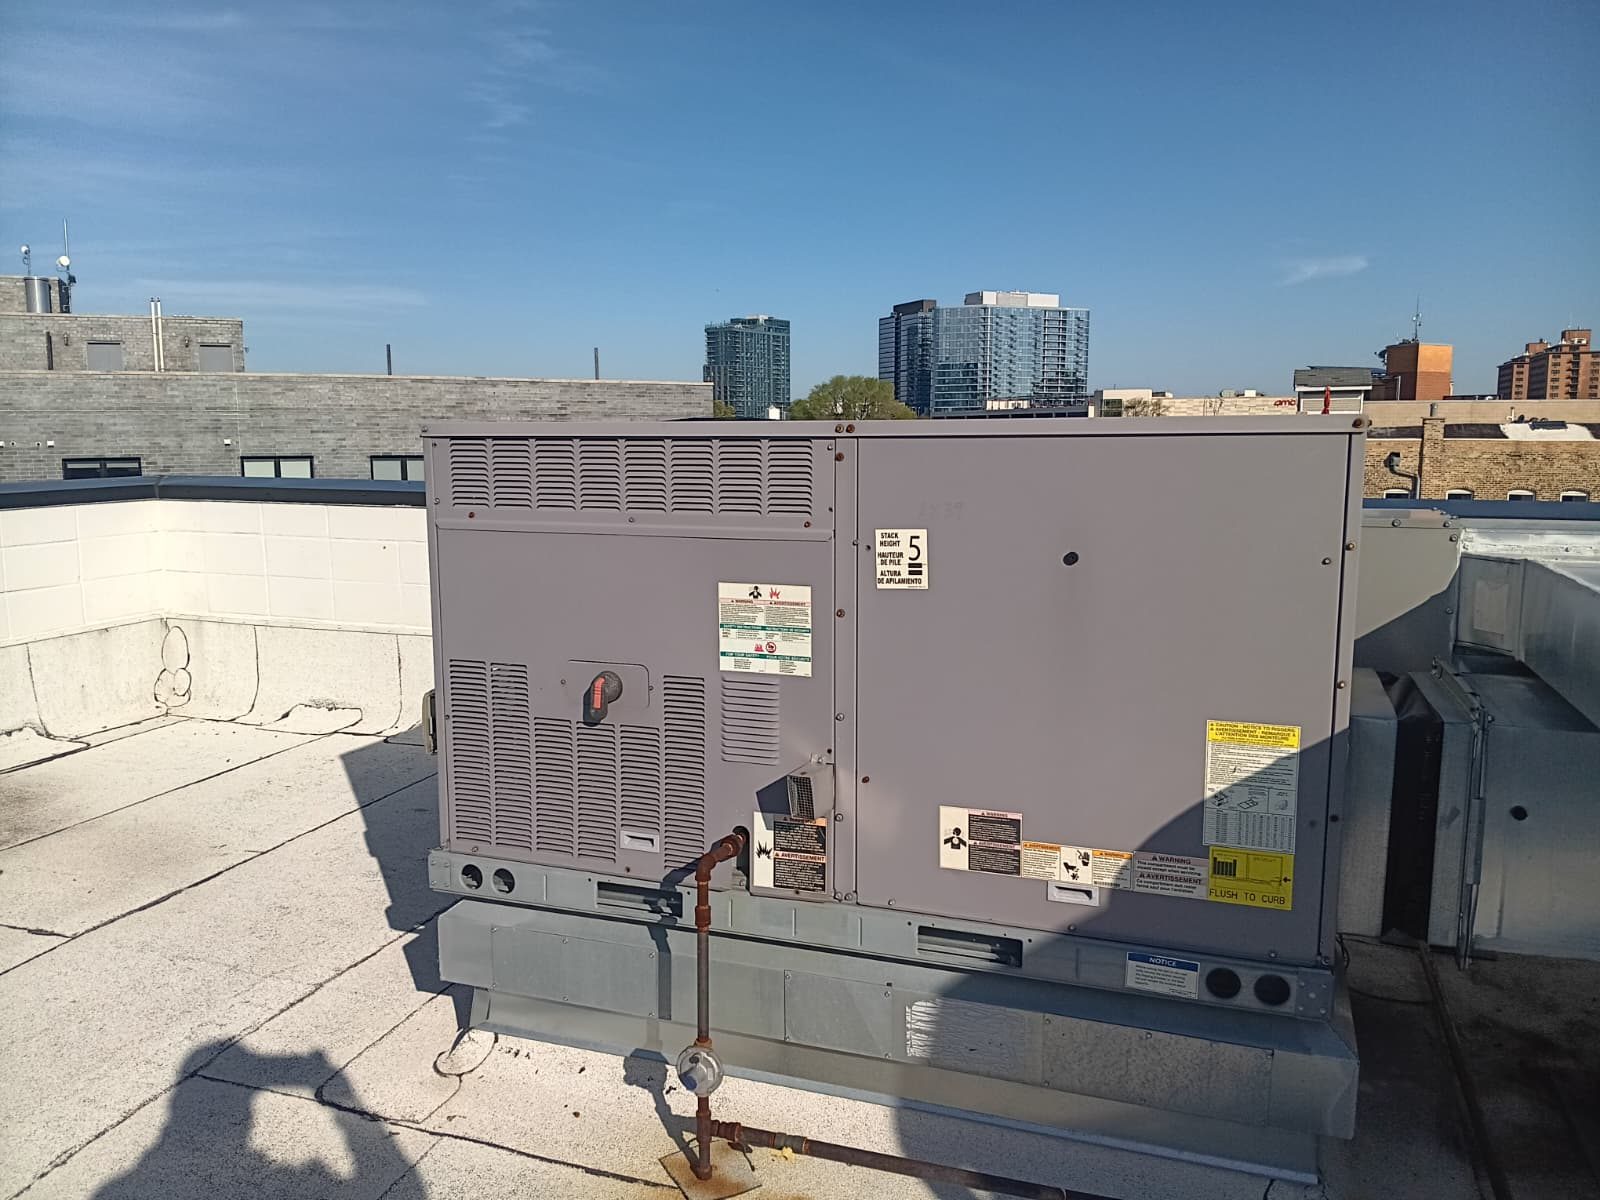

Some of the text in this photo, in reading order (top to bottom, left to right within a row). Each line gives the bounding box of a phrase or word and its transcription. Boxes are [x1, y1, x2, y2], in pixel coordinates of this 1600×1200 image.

[908, 535, 921, 561] 5
[781, 853, 825, 862] AVERTISSEMENT
[1158, 856, 1191, 865] WARNING
[1146, 872, 1202, 885] AVERTISSEMENT
[1209, 889, 1286, 905] FLUSH TO CURB
[1149, 957, 1177, 967] NOTICE
